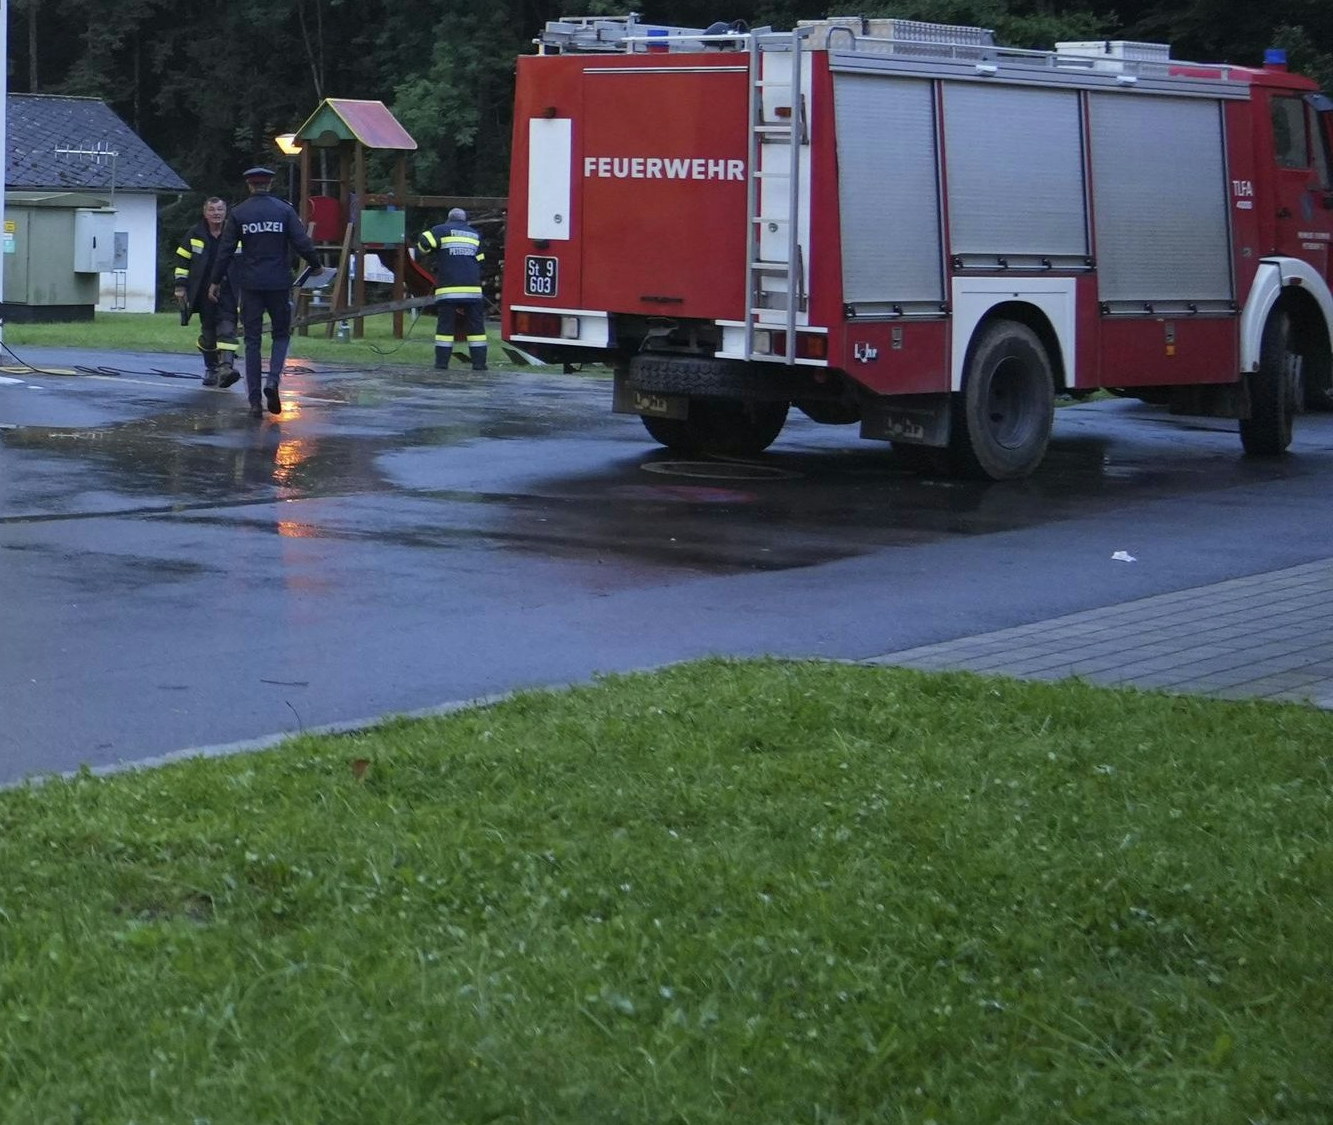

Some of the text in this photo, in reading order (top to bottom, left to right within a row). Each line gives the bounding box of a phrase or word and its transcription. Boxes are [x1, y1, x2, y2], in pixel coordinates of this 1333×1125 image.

[584, 157, 745, 181] FEUERWEHR
[1232, 180, 1253, 196] TLFA
[242, 221, 284, 235] POLIZEI
[528, 259, 554, 277] St 9
[530, 276, 551, 293] 603
